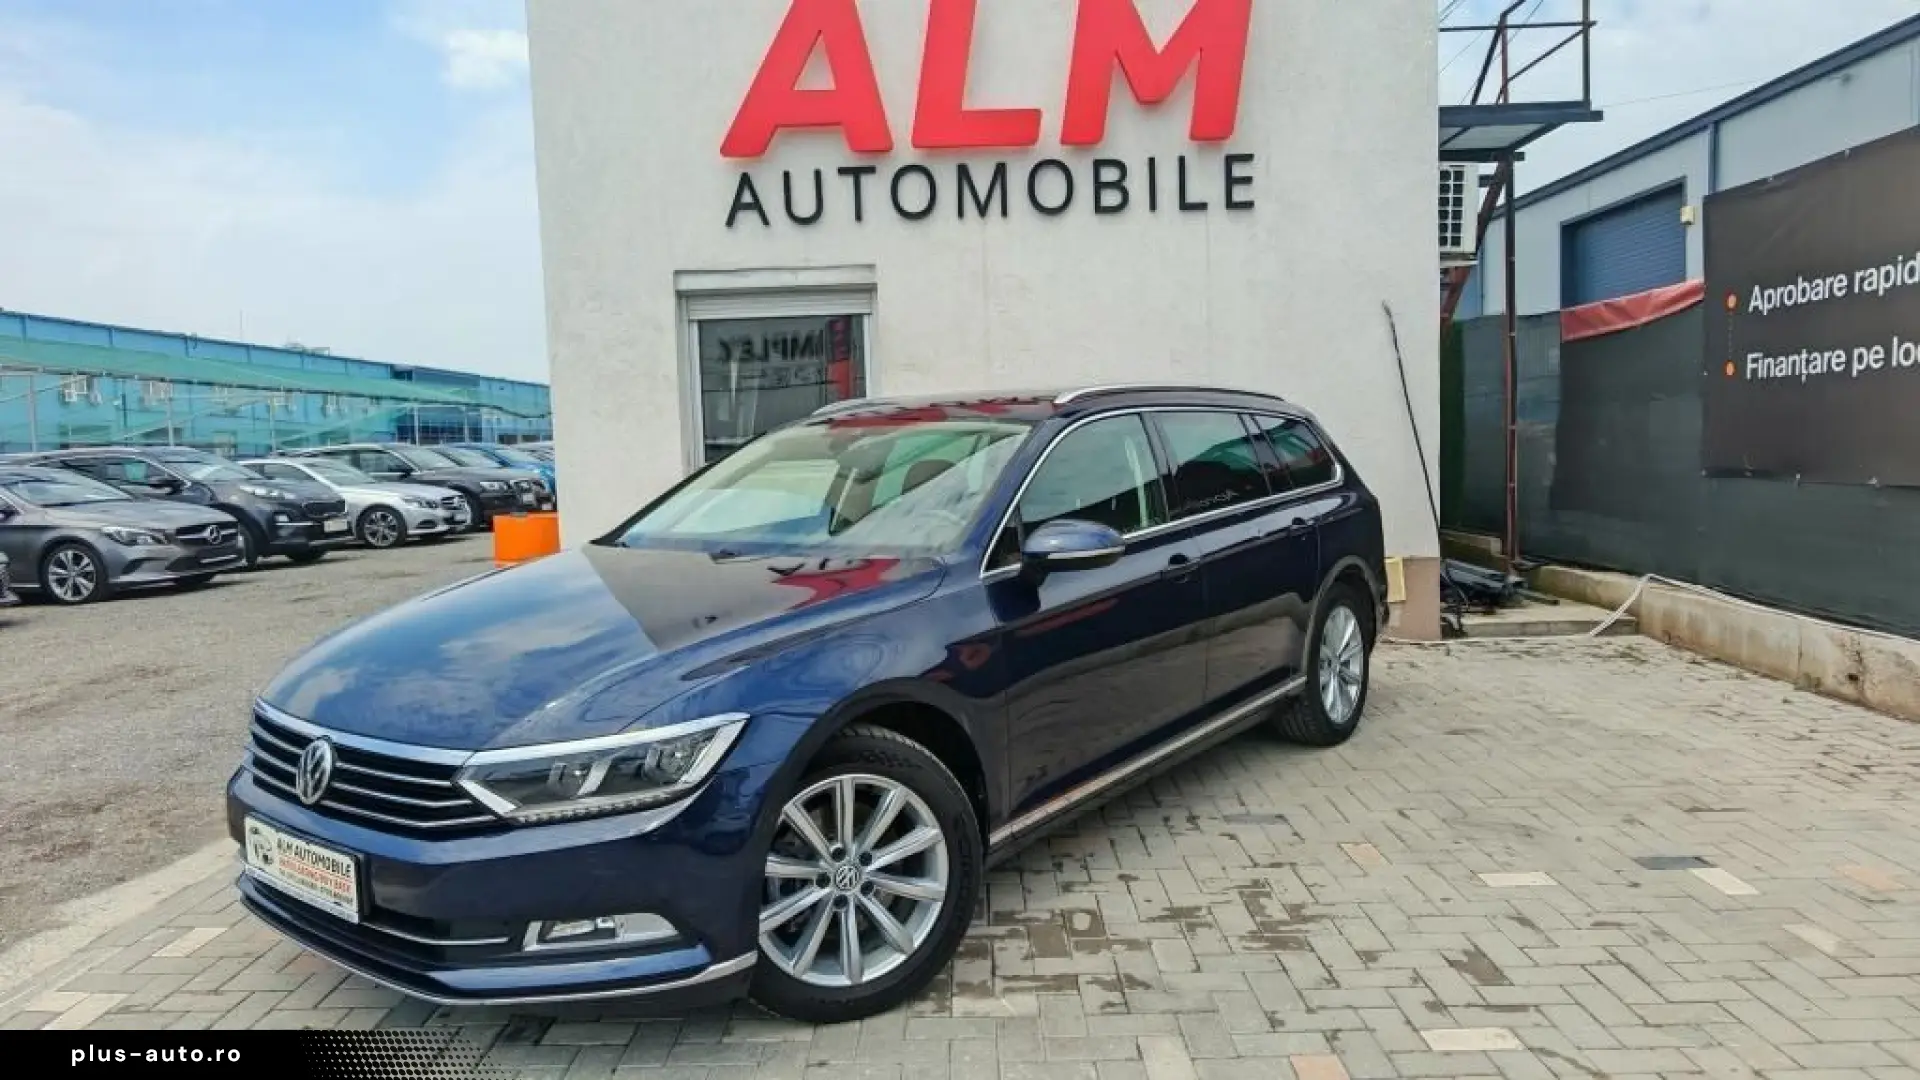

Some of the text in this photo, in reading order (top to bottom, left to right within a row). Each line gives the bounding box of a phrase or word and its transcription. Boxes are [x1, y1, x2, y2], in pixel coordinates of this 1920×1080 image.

[720, 0, 1252, 158] ALM
[726, 153, 1256, 228] AUTOMOBILE
[1749, 273, 1848, 316] Aprobare
[1746, 335, 1920, 384] Finanțare pe lo
[294, 844, 352, 879] AUTOMOBILE
